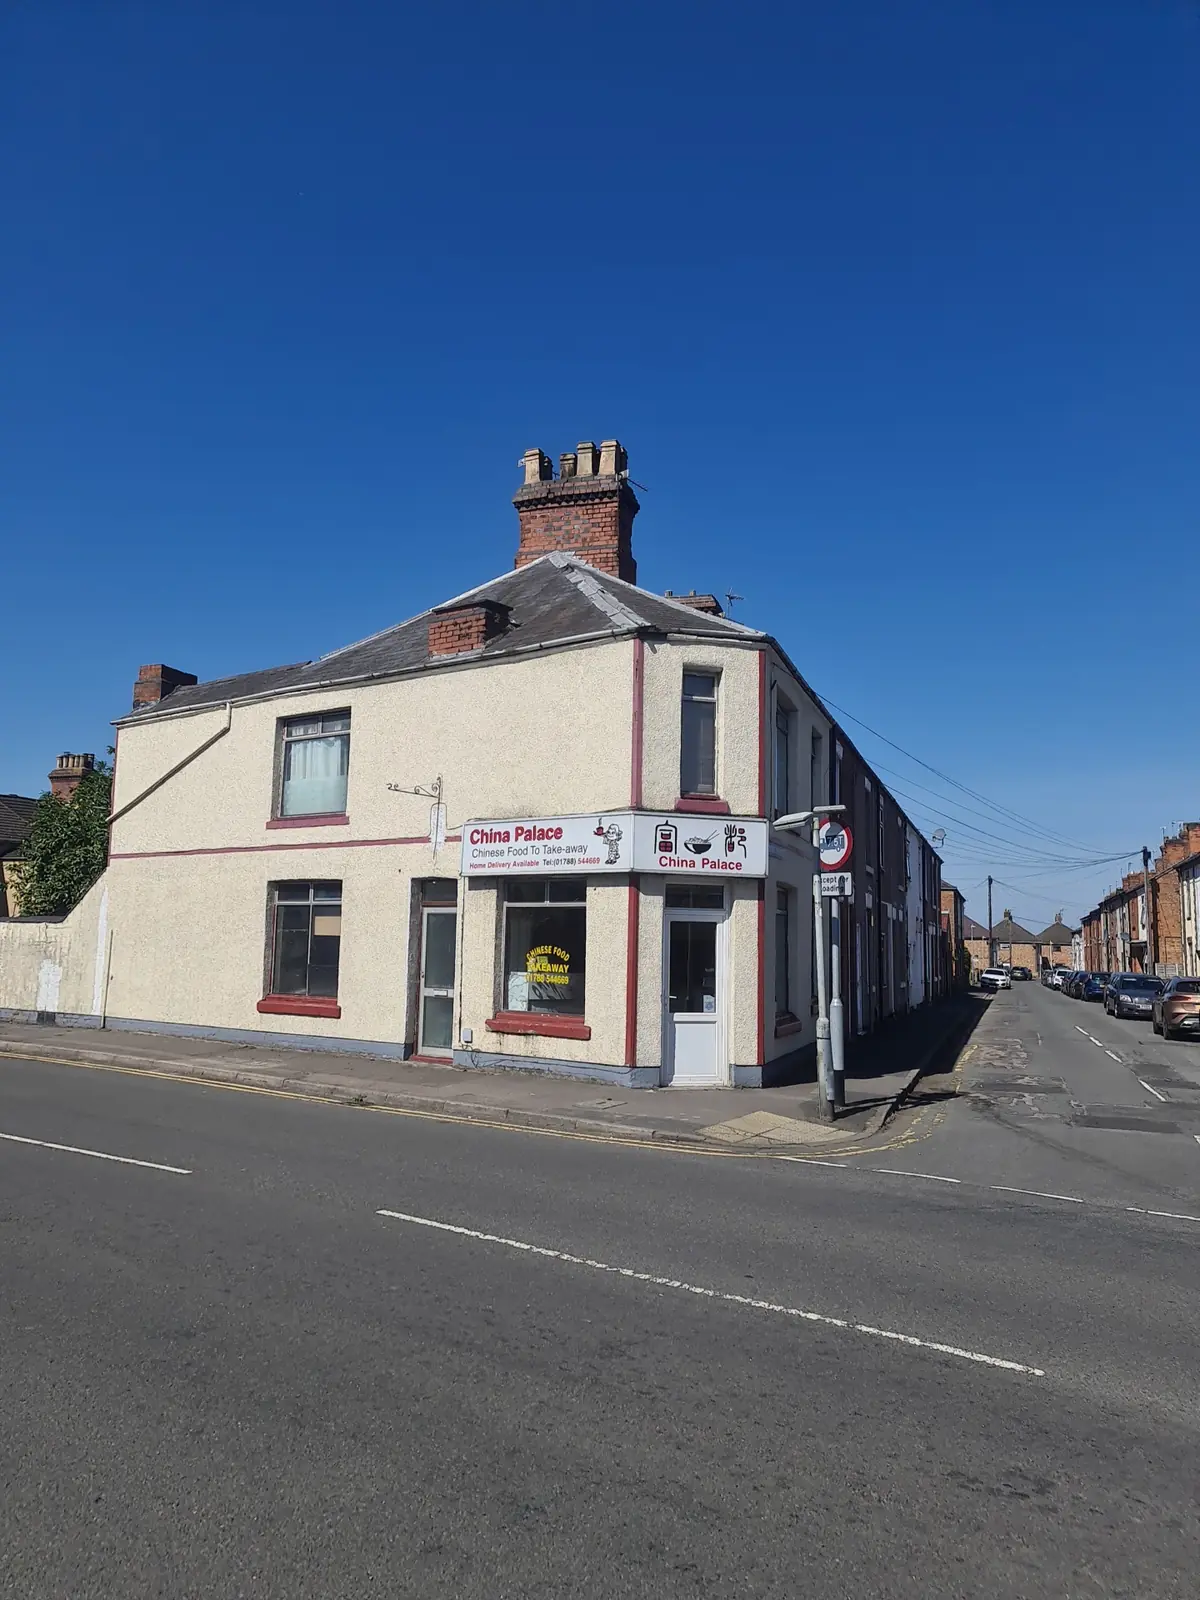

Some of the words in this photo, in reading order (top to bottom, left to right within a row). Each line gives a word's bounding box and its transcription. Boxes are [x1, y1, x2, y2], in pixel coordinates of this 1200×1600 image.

[470, 828, 510, 845] China
[515, 825, 563, 842] Palace
[472, 847, 505, 858] Chinese
[507, 845, 529, 856] Food
[530, 845, 540, 855] To
[543, 844, 588, 855] Take-away
[487, 861, 511, 869] Delivery
[577, 857, 600, 865] 544669
[659, 856, 696, 868] China
[702, 857, 743, 870] Palace
[821, 876, 837, 884] cept
[822, 884, 844, 893] oading
[526, 945, 552, 961] CHINESE
[553, 946, 570, 962] FOOD
[526, 962, 570, 973] TAKEAWAY
[546, 974, 569, 985] 544669
